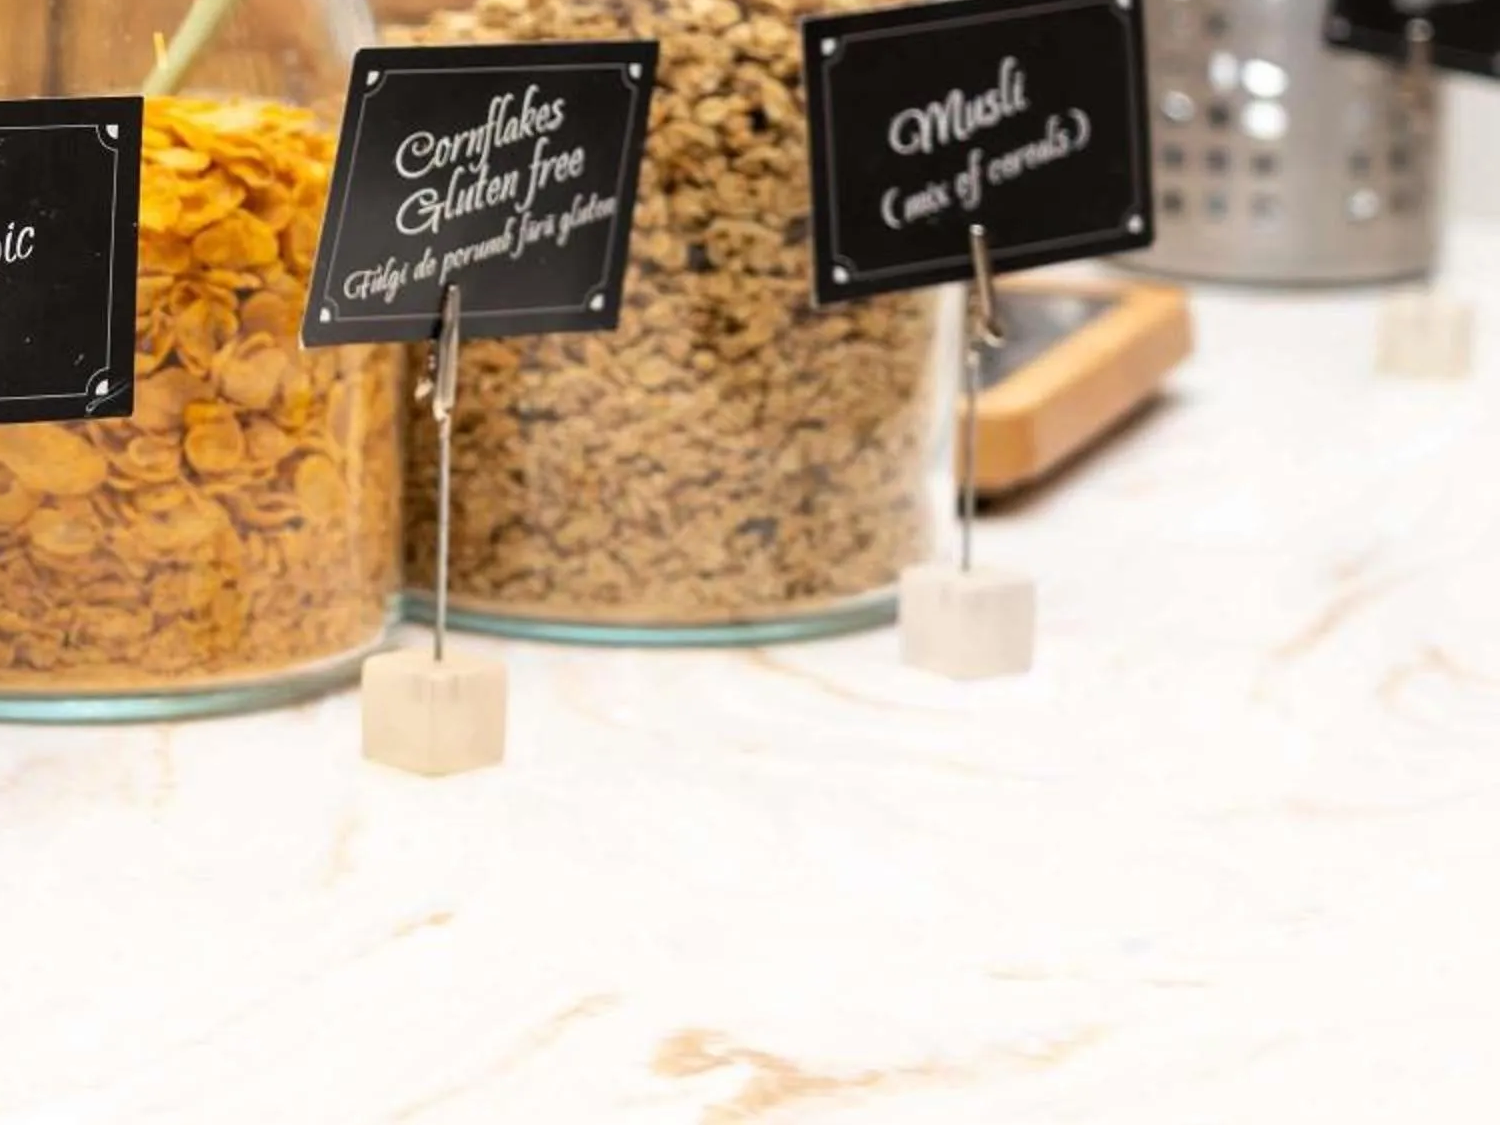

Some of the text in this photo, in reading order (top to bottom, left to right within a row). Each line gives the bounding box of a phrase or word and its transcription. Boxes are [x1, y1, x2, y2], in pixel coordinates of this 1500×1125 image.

[395, 84, 566, 179] Cornflakes
[888, 55, 1030, 155] Musli
[395, 136, 586, 235] Gluten free
[953, 147, 985, 211] of
[412, 246, 439, 282] de
[556, 191, 617, 247] gluten
